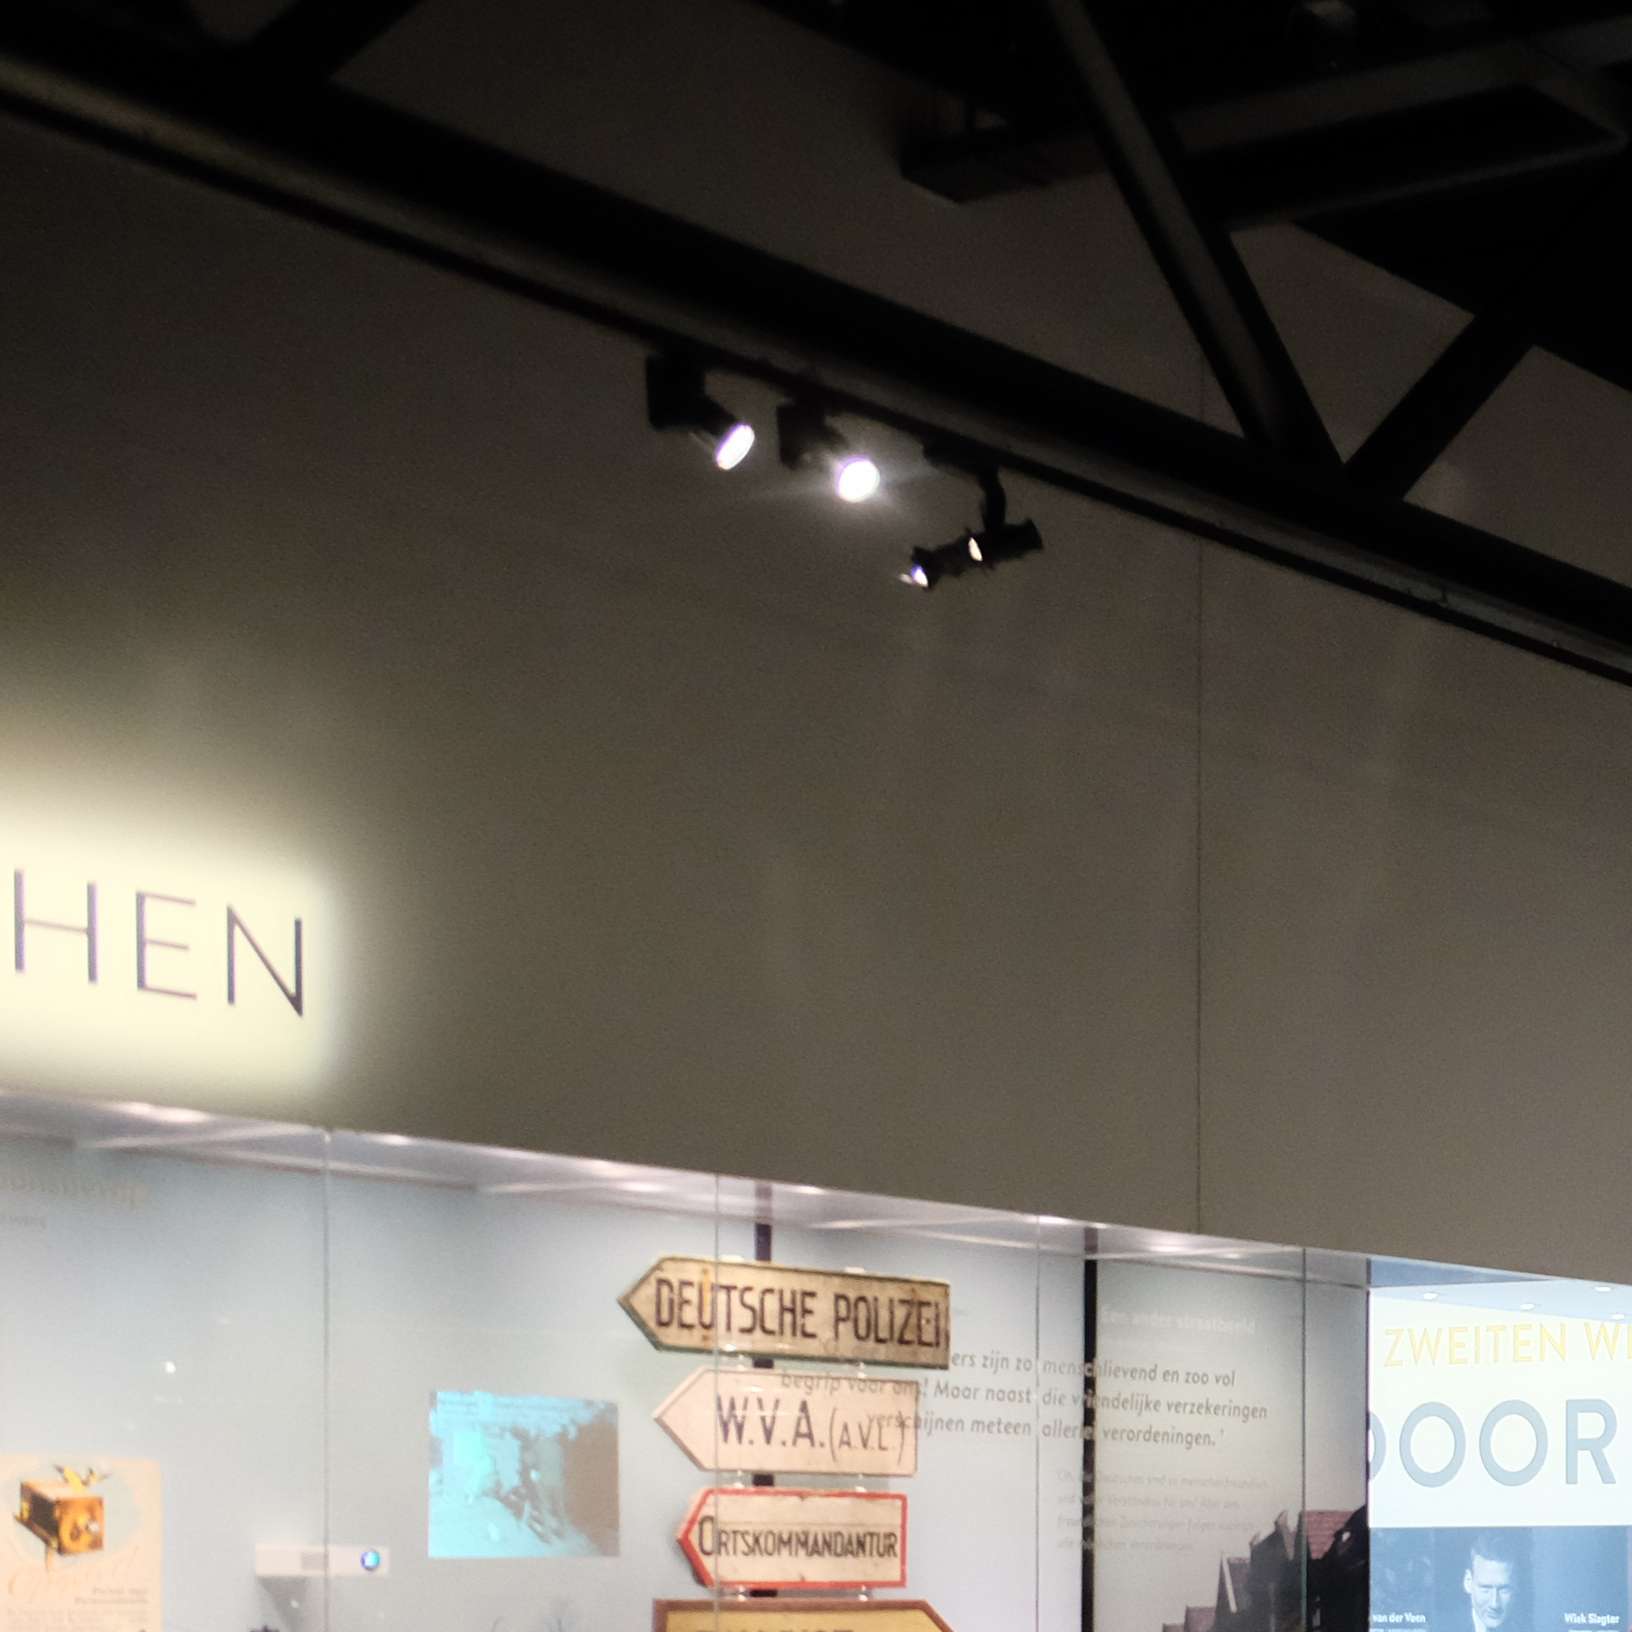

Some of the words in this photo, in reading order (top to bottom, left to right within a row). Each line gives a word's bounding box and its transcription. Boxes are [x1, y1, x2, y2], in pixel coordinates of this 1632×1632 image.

[14, 868, 304, 1017] HEN
[655, 1278, 817, 1340] DEUTSCHE
[834, 1294, 941, 1348] POLIZEI
[1384, 1323, 1567, 1368] ZWEITEN
[982, 1350, 1009, 1374] zijn
[1163, 1368, 1180, 1383] en
[1185, 1371, 1210, 1386] zoo
[1215, 1370, 1236, 1388] vol
[935, 1380, 981, 1402] Maar
[985, 1385, 1032, 1406] naast
[1042, 1386, 1067, 1407] die
[1167, 1399, 1268, 1424] verzekeringen
[970, 1417, 1032, 1436] meteen
